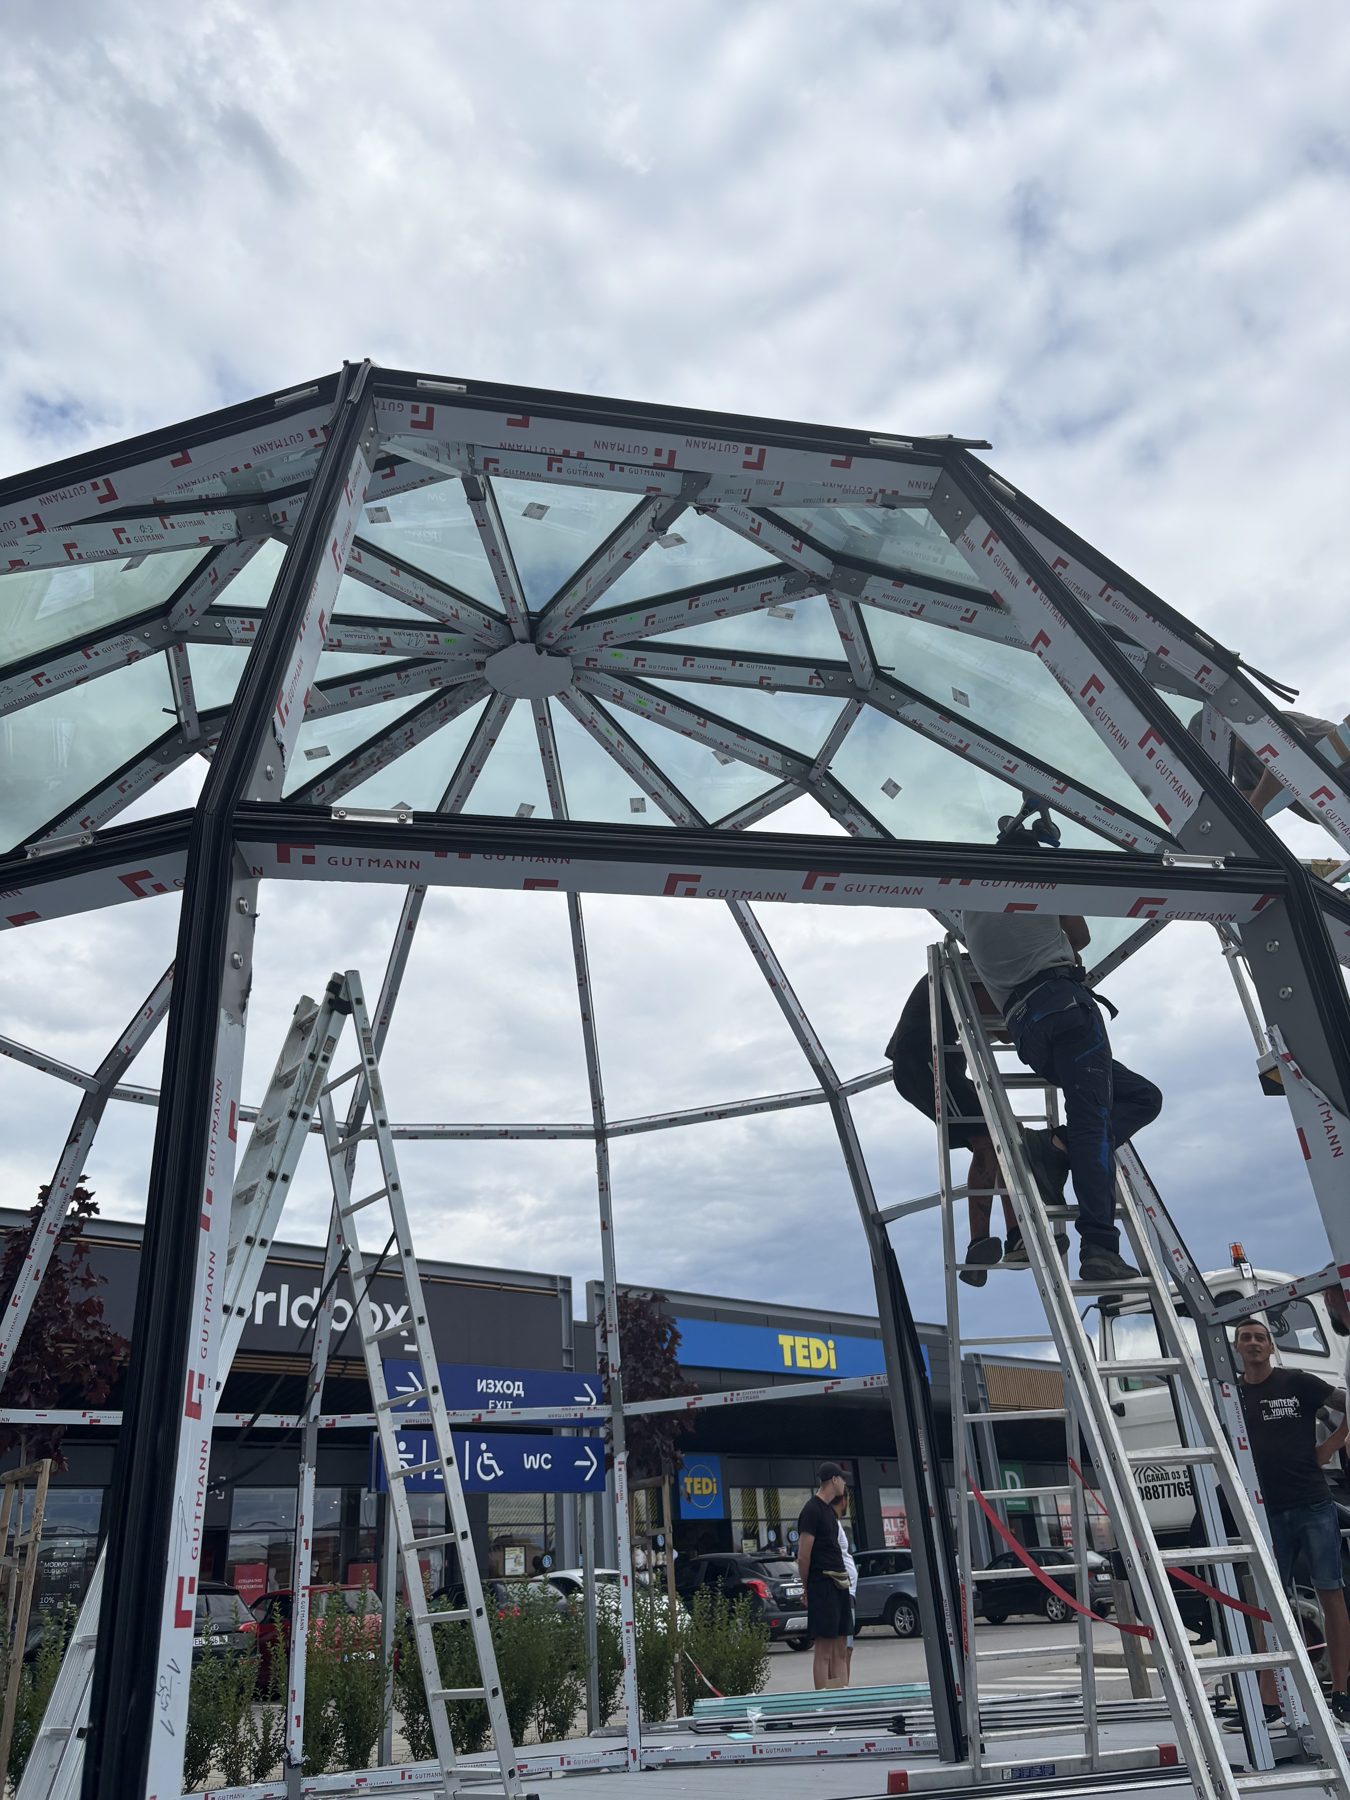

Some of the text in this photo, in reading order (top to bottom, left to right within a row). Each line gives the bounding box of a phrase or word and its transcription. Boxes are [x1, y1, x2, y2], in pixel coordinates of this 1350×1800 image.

[252, 433, 304, 456] GUTMANN
[594, 439, 649, 455] GUTMANN
[685, 438, 739, 454] GUTMANN
[503, 468, 542, 478] GUTMANN
[566, 468, 605, 478] GUTMANN
[628, 467, 666, 478] GUTMANN
[38, 485, 87, 506] GUTMANN
[177, 519, 206, 529] GUTMANN
[133, 533, 165, 544] GUTMANN
[993, 555, 1020, 589] GUTMANN
[747, 578, 778, 590] GUTMANN
[1063, 576, 1091, 602] GUTMANN
[701, 596, 730, 607] GUTMANN
[882, 593, 911, 606] GUTMANN
[931, 599, 963, 612] GUTMANN
[657, 613, 685, 624] GUTMANN
[1039, 593, 1069, 629] GUTMANN
[1111, 600, 1140, 623] GUTMANN
[101, 637, 134, 653] GUTMANN
[54, 664, 88, 680] GUTMANN
[648, 664, 678, 672] GUTMANN
[697, 664, 727, 672] GUTMANN
[746, 663, 776, 672] GUTMANN
[3, 691, 39, 708] GUTMANN
[1095, 706, 1130, 751] GUTMANN
[1266, 718, 1298, 750] GUTMANN
[976, 741, 1005, 761] GUTMANN
[1155, 759, 1194, 808] GUTMANN
[1269, 765, 1302, 798] GUTMANN
[1092, 813, 1124, 834] GUTMANN
[327, 855, 421, 871] GUTMANN
[706, 888, 787, 901] GUTMANN
[843, 883, 923, 896] GUTMANN
[1164, 910, 1236, 922] GUTMANN
[208, 1078, 223, 1177] GUTMANN
[56, 1192, 69, 1221] GUTMANN
[201, 1250, 216, 1359] GUTMANN
[6, 1312, 20, 1342] GUTMANN
[778, 1334, 837, 1370] TEDi
[476, 1379, 525, 1396] ИЗХОД
[1233, 1401, 1245, 1434] GUTMANN
[523, 1453, 552, 1470] WC
[684, 1477, 717, 1496] TEDi
[191, 1439, 209, 1561] GUTMANN
[573, 1757, 600, 1766] GUTMANN
